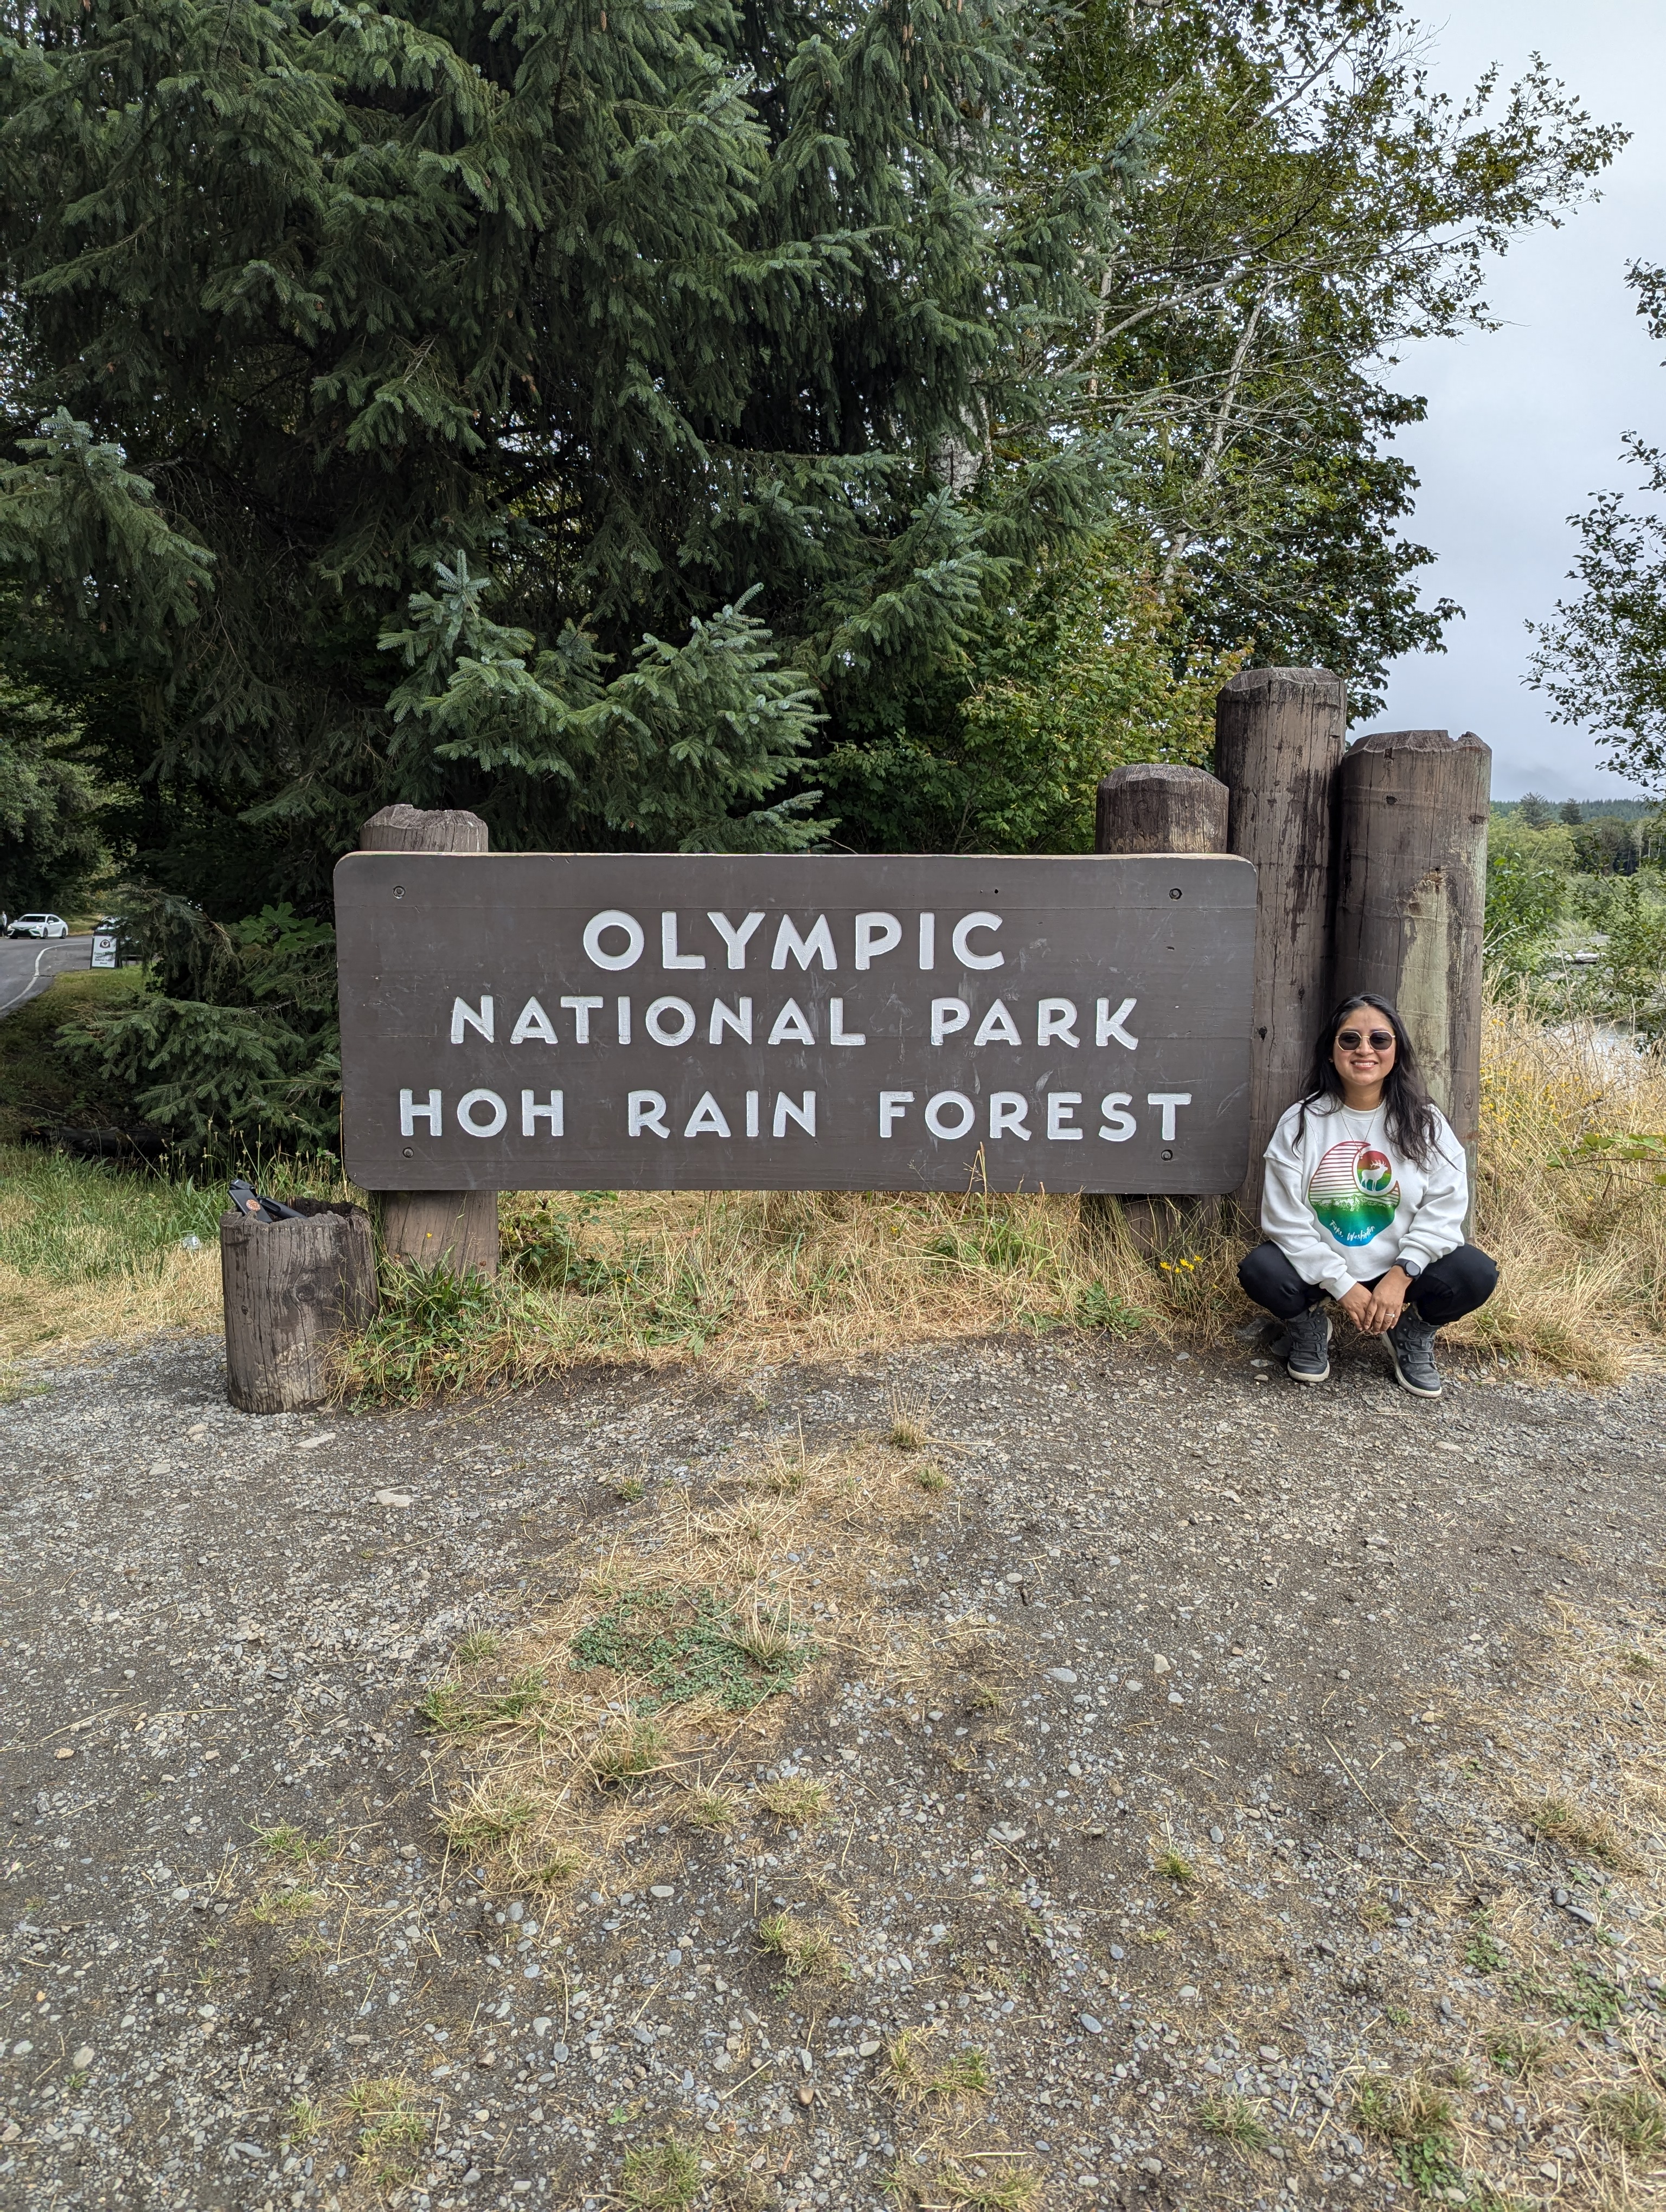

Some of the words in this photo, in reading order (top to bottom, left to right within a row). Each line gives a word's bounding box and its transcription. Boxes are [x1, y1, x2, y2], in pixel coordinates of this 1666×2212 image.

[584, 910, 1004, 970] OLYMPIC
[451, 995, 866, 1046] NATIONAL
[931, 998, 1138, 1050] PARK
[400, 1089, 563, 1137] HOH
[629, 1090, 816, 1139] RAIN
[880, 1091, 1191, 1141] FOREST
